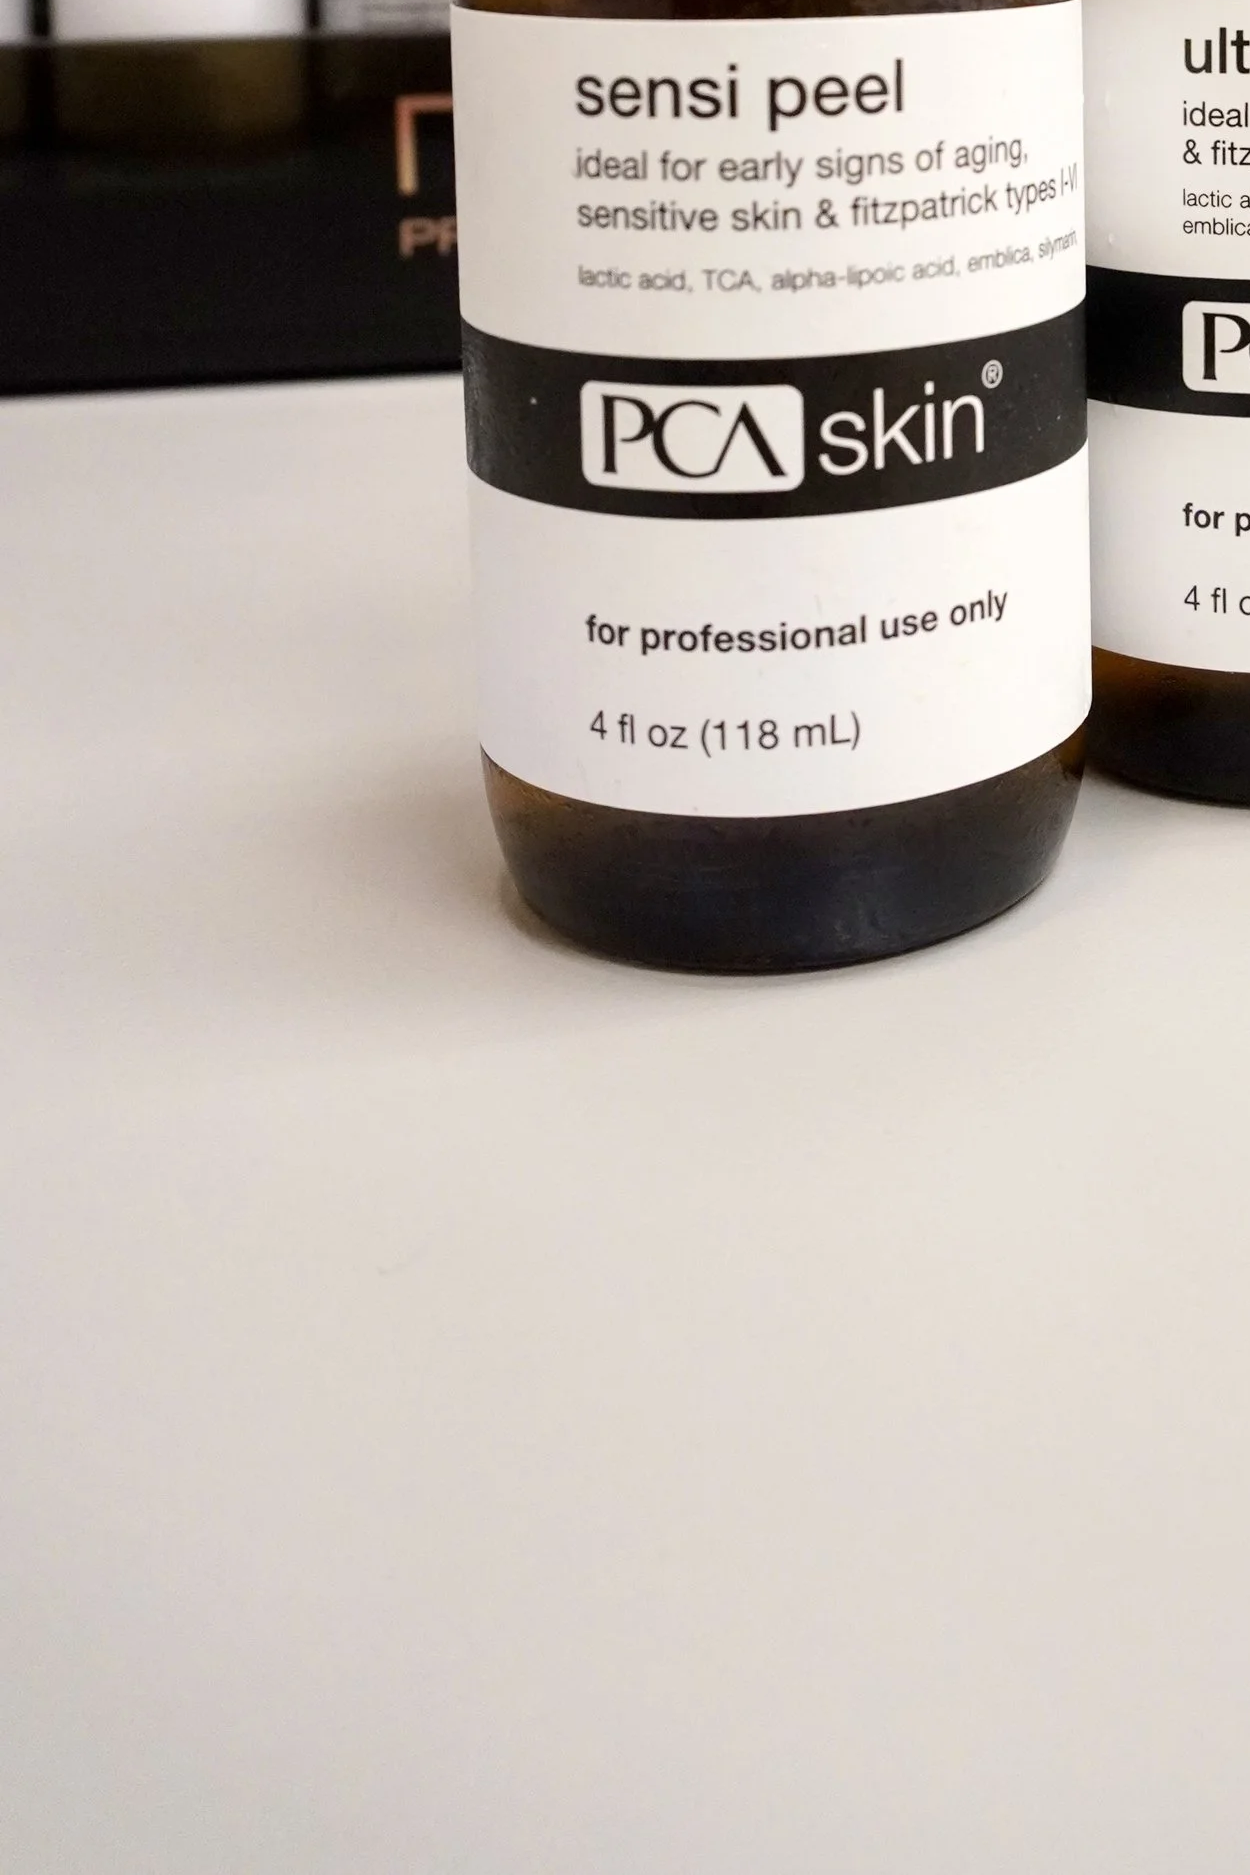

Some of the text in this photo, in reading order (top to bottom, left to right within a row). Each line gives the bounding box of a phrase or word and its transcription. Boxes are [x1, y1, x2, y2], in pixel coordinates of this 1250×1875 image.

[576, 58, 903, 133] sensi peel
[1183, 100, 1249, 128] ideal
[576, 139, 1028, 189] ideal for early signs of aging,
[1182, 138, 1202, 165] &
[577, 203, 719, 232] sensitive
[731, 201, 802, 232] skin
[815, 198, 839, 229] &
[850, 187, 998, 230] fitzpatrick
[1005, 178, 1057, 215] types
[1182, 188, 1233, 209] lactic
[577, 265, 632, 290] lactic
[638, 271, 693, 293] acid,
[702, 268, 762, 292] TCA,
[770, 266, 904, 294] alpha-lipoic
[911, 255, 960, 281] acid,
[967, 246, 1034, 273] emblica,
[601, 394, 787, 479] PCA
[1182, 502, 1225, 530] for
[585, 589, 1008, 656] for professional use only
[1183, 584, 1201, 611] 4
[1210, 586, 1227, 614] fl
[590, 710, 861, 758] 4 fl oz (118 mL)
